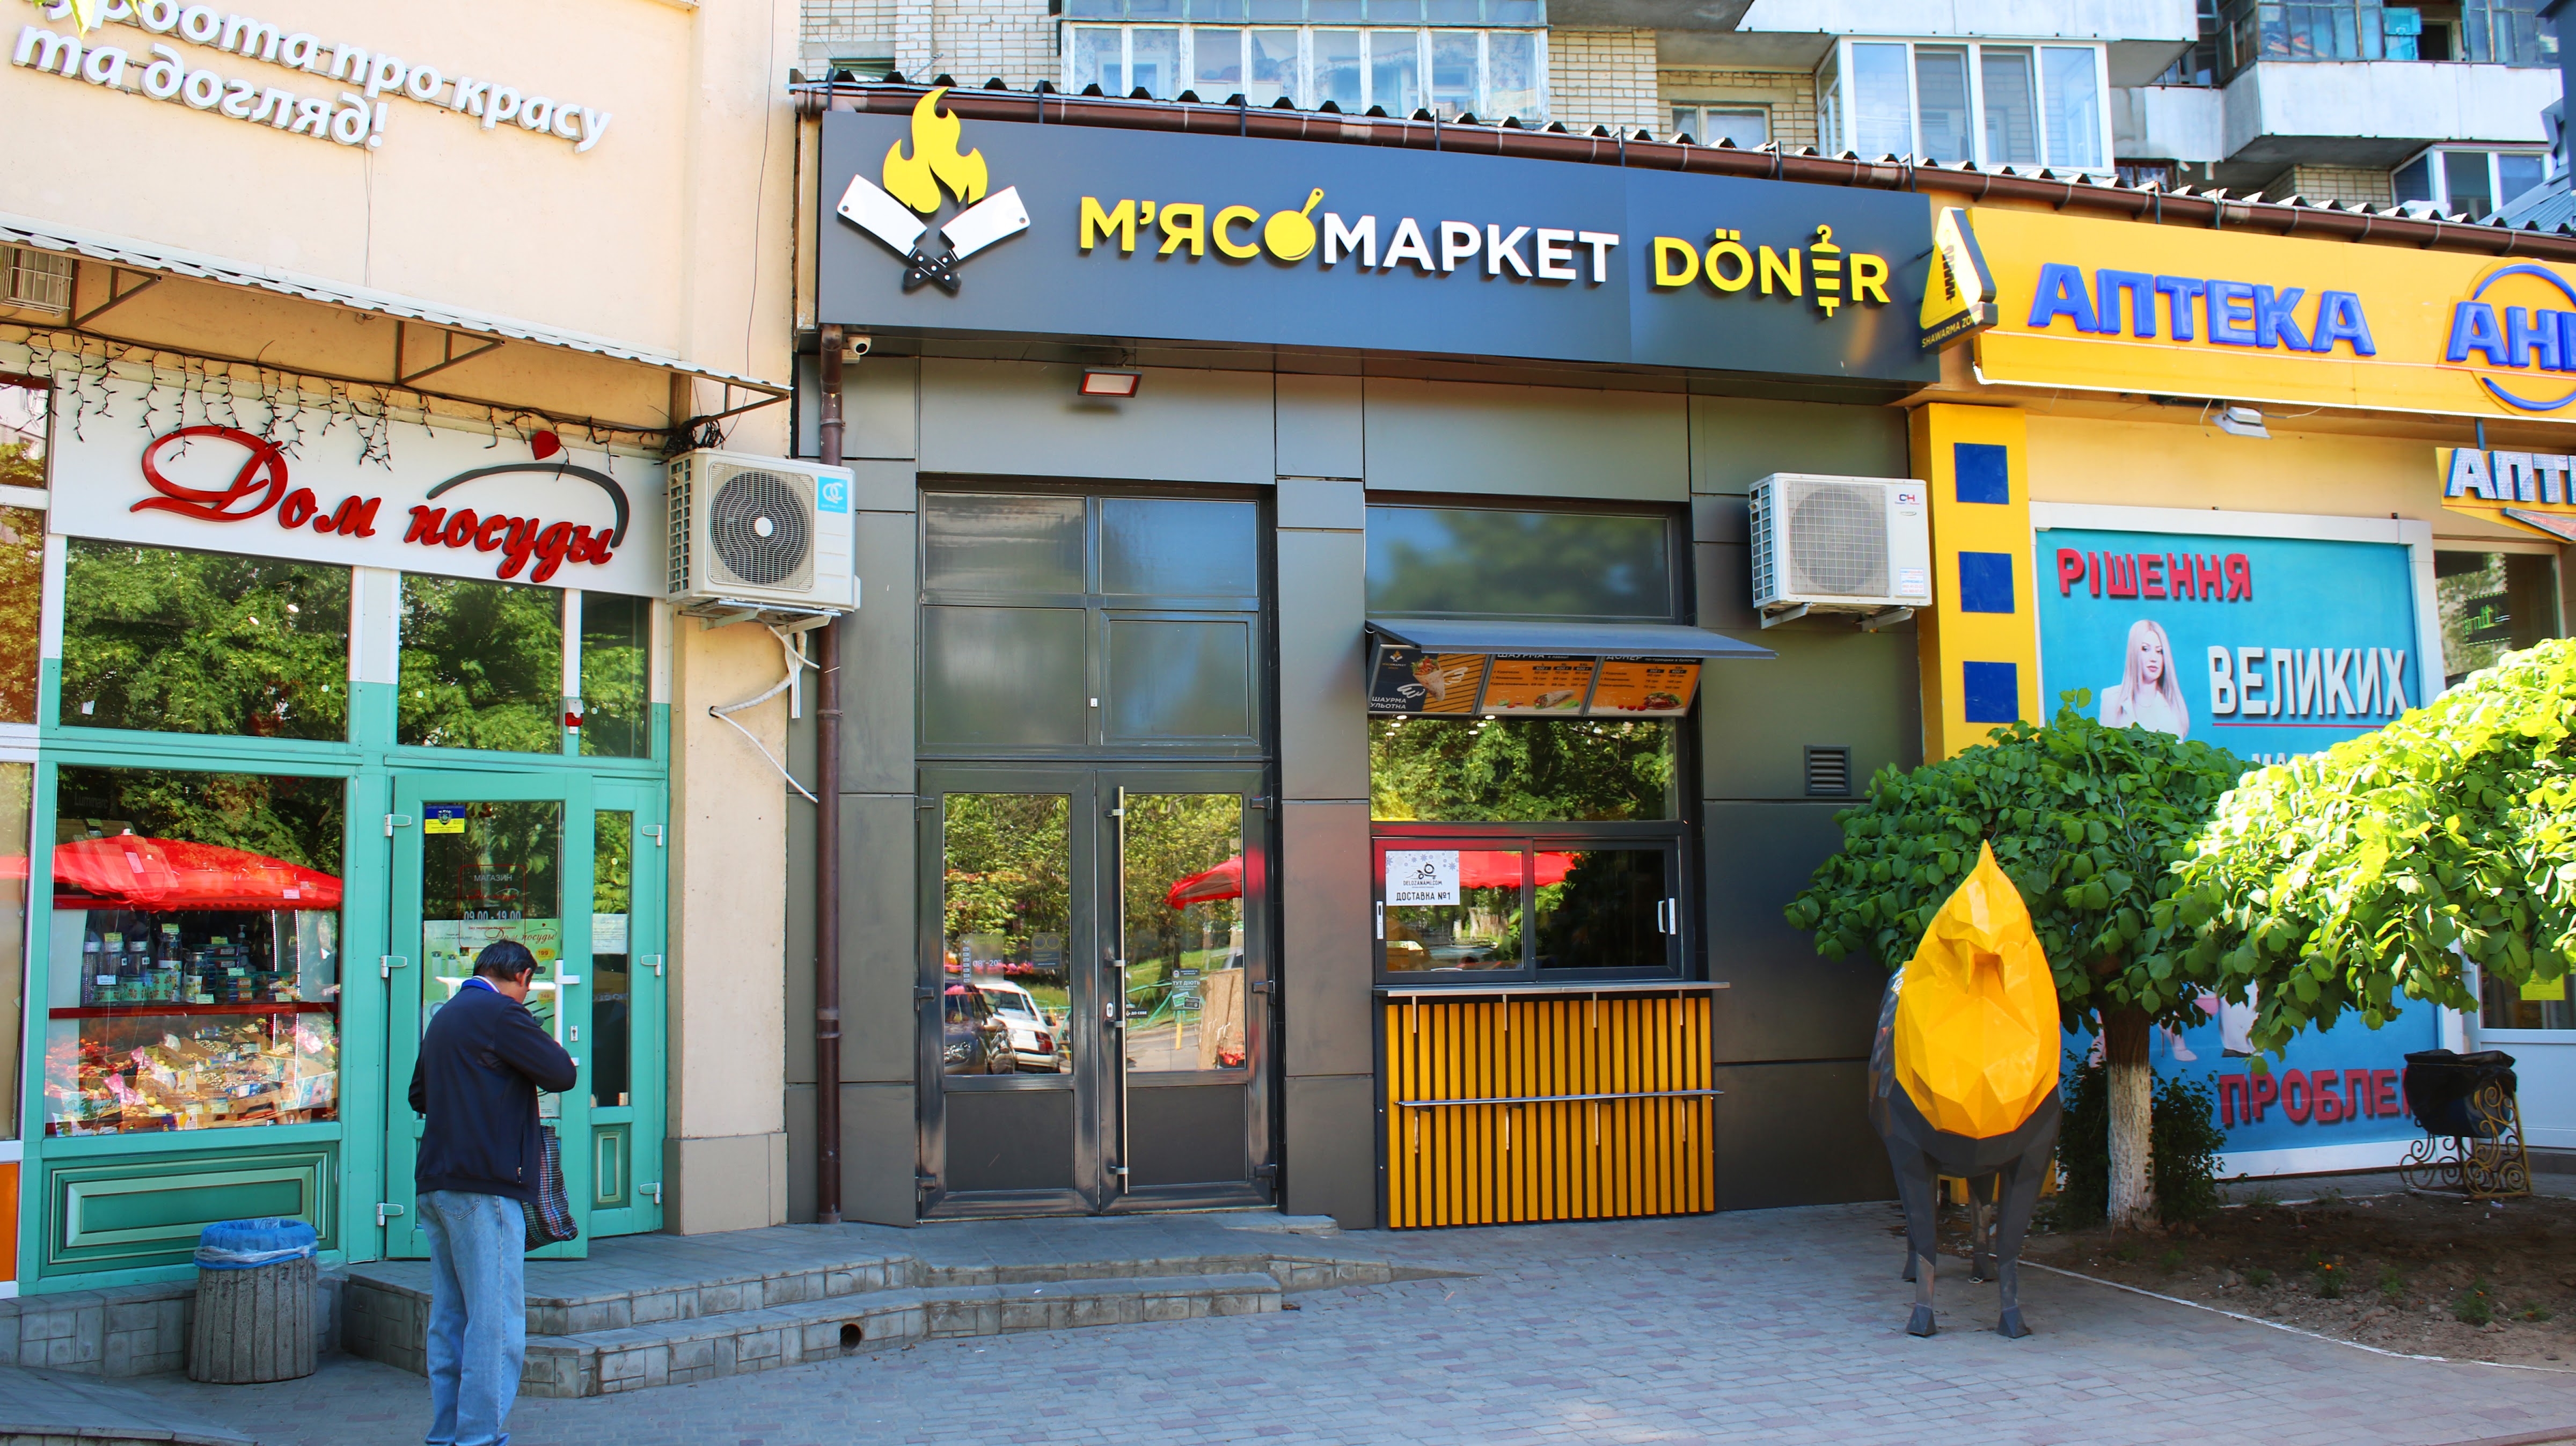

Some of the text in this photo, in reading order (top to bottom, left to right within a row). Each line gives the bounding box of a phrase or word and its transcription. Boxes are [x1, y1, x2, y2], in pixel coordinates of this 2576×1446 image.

[12, 25, 389, 151] та догляд!
[328, 43, 443, 101] про
[450, 76, 612, 154] красу
[1921, 322, 1961, 348] SHAWARMA
[2028, 261, 2377, 356] АПТЕКА
[2446, 301, 2576, 373] АН
[1899, 494, 1915, 502] CH
[2444, 447, 2576, 505] АПТ
[129, 425, 615, 583] Дом посуды
[2056, 547, 2252, 601] РІШЕННЯ
[1372, 696, 1407, 704] ШАУРМА
[2207, 645, 2409, 717] ВЕЛИКИХ
[474, 874, 513, 882] МАГАЗИН
[1396, 892, 1451, 902] ДОСТАВКА №1
[464, 910, 489, 921] 09.00
[496, 910, 521, 920] 19.00
[521, 933, 556, 944] посуды
[2219, 1068, 2412, 1125] ПРОБЛЕ
